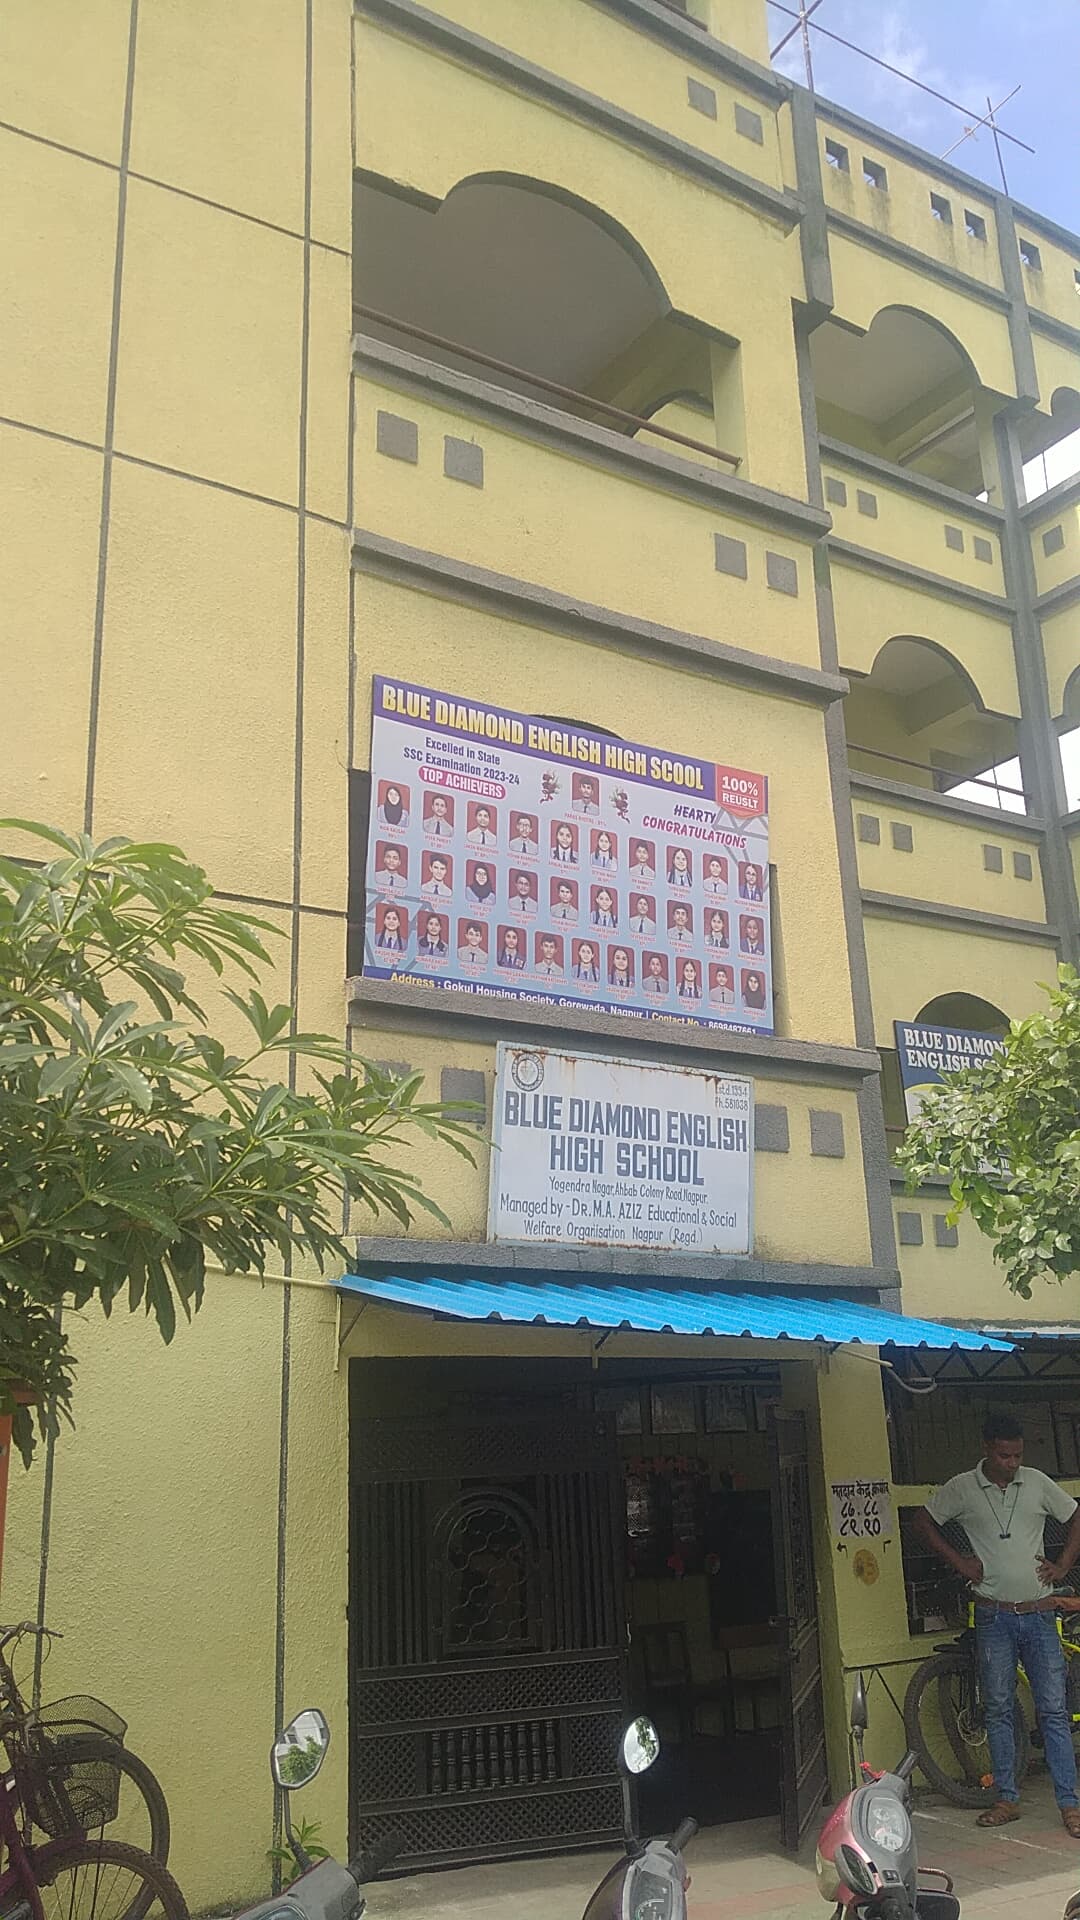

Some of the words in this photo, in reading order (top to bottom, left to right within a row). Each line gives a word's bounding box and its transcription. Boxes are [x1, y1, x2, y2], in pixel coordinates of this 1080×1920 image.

[382, 684, 431, 721] BLUE
[435, 700, 524, 745] DIAMOND
[528, 724, 600, 765] ENGLISH
[605, 744, 647, 777] HIGH
[650, 756, 704, 790] SCOOL
[425, 736, 465, 757] Excelled
[477, 750, 501, 766] State
[403, 747, 423, 762] SSC
[425, 753, 481, 776] Examination
[483, 767, 520, 786] 2023-24
[423, 767, 443, 783] TOP
[445, 772, 503, 798] ACHIEVERS
[722, 776, 758, 796] 100%
[674, 804, 716, 824] HEARTY
[722, 793, 758, 809] REUSLT
[643, 815, 747, 848] CONGRATULATIONS
[390, 972, 435, 988] Address
[444, 981, 473, 993] Gokul
[476, 986, 517, 999] Housing
[903, 1028, 944, 1050] BLUE
[945, 1034, 1009, 1058] DIAMON
[906, 1049, 971, 1073] ENGLISH
[505, 1091, 563, 1130] BLUE
[569, 1097, 661, 1142] DIAMOND
[667, 1110, 747, 1152] ENGLISH
[550, 1135, 604, 1174] HIGH
[616, 1142, 705, 1186] SCHOOL
[549, 1176, 590, 1193] Yogendra
[640, 1183, 664, 1201] Colony
[500, 1193, 548, 1218] Managed
[550, 1197, 564, 1218] by
[618, 1202, 642, 1220] AZIZ
[648, 1204, 700, 1225] Educational
[701, 1211, 708, 1226] &
[709, 1209, 737, 1228] Social
[524, 1219, 562, 1236] Welfare
[632, 1226, 664, 1244] Nagpur
